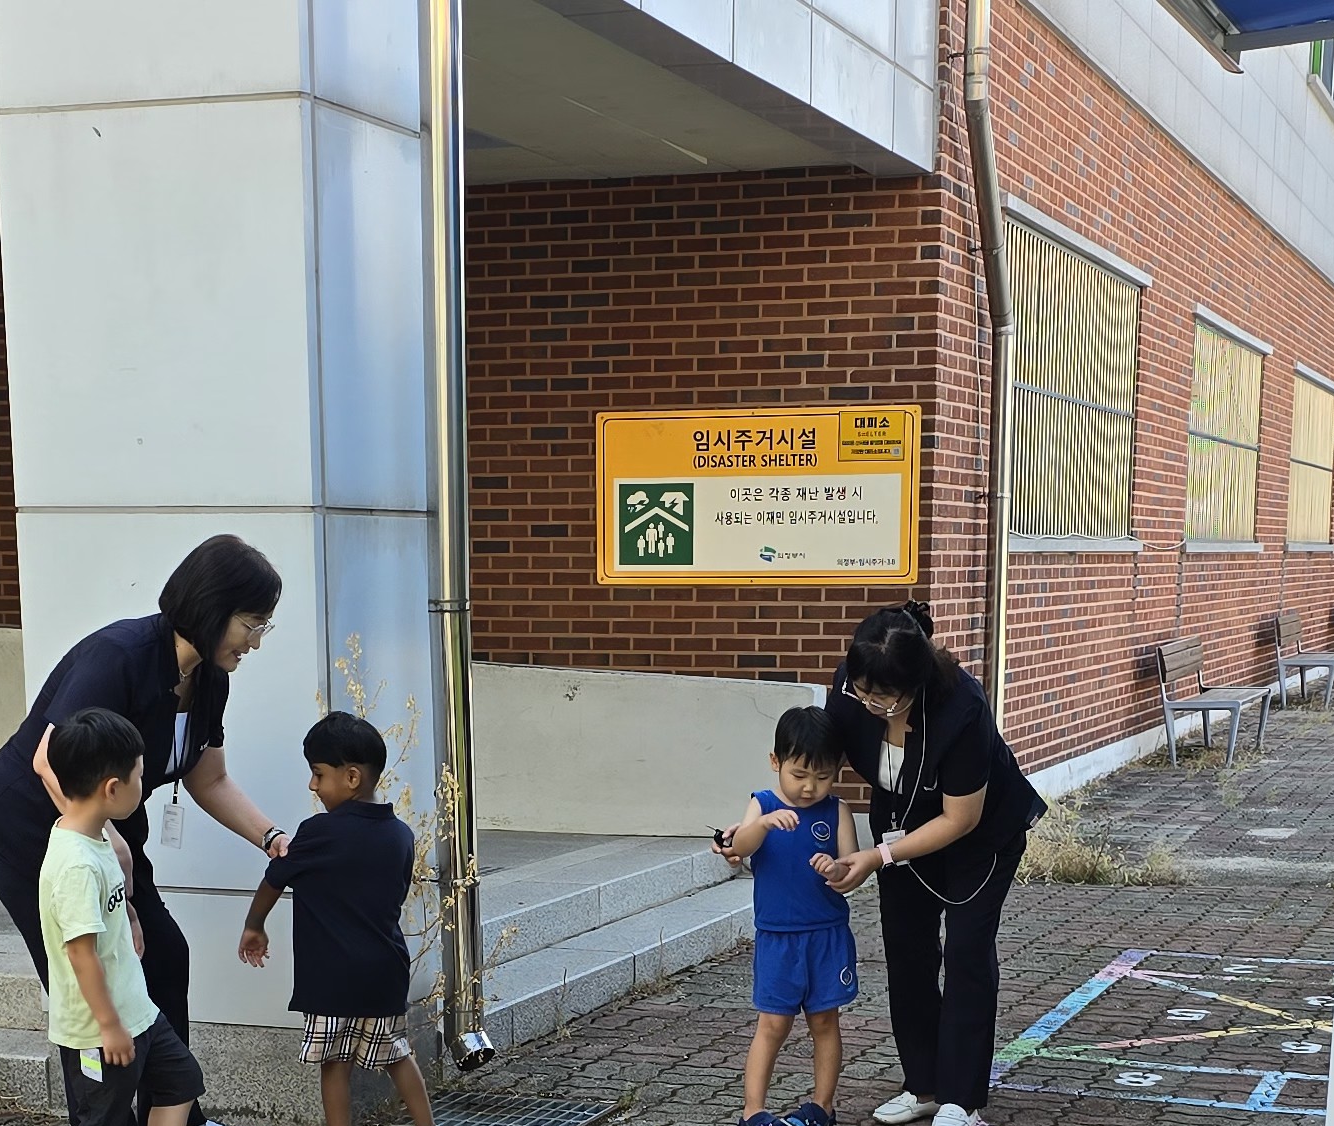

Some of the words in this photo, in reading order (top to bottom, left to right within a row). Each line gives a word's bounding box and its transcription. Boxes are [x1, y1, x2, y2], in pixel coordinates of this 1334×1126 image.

[854, 417, 890, 429] 대피소
[692, 427, 817, 452] 임시주거시설
[692, 454, 757, 469] (DISASTER
[760, 453, 818, 468] SHELTER)
[729, 487, 765, 502] 이곳은
[768, 487, 792, 502] 각종
[795, 486, 820, 501] 재난
[823, 485, 848, 501] 발생
[851, 485, 863, 501] 시
[714, 510, 753, 526] 사용되는
[756, 510, 786, 526] 이재민
[787, 508, 879, 526] 임시주거시설입니다.
